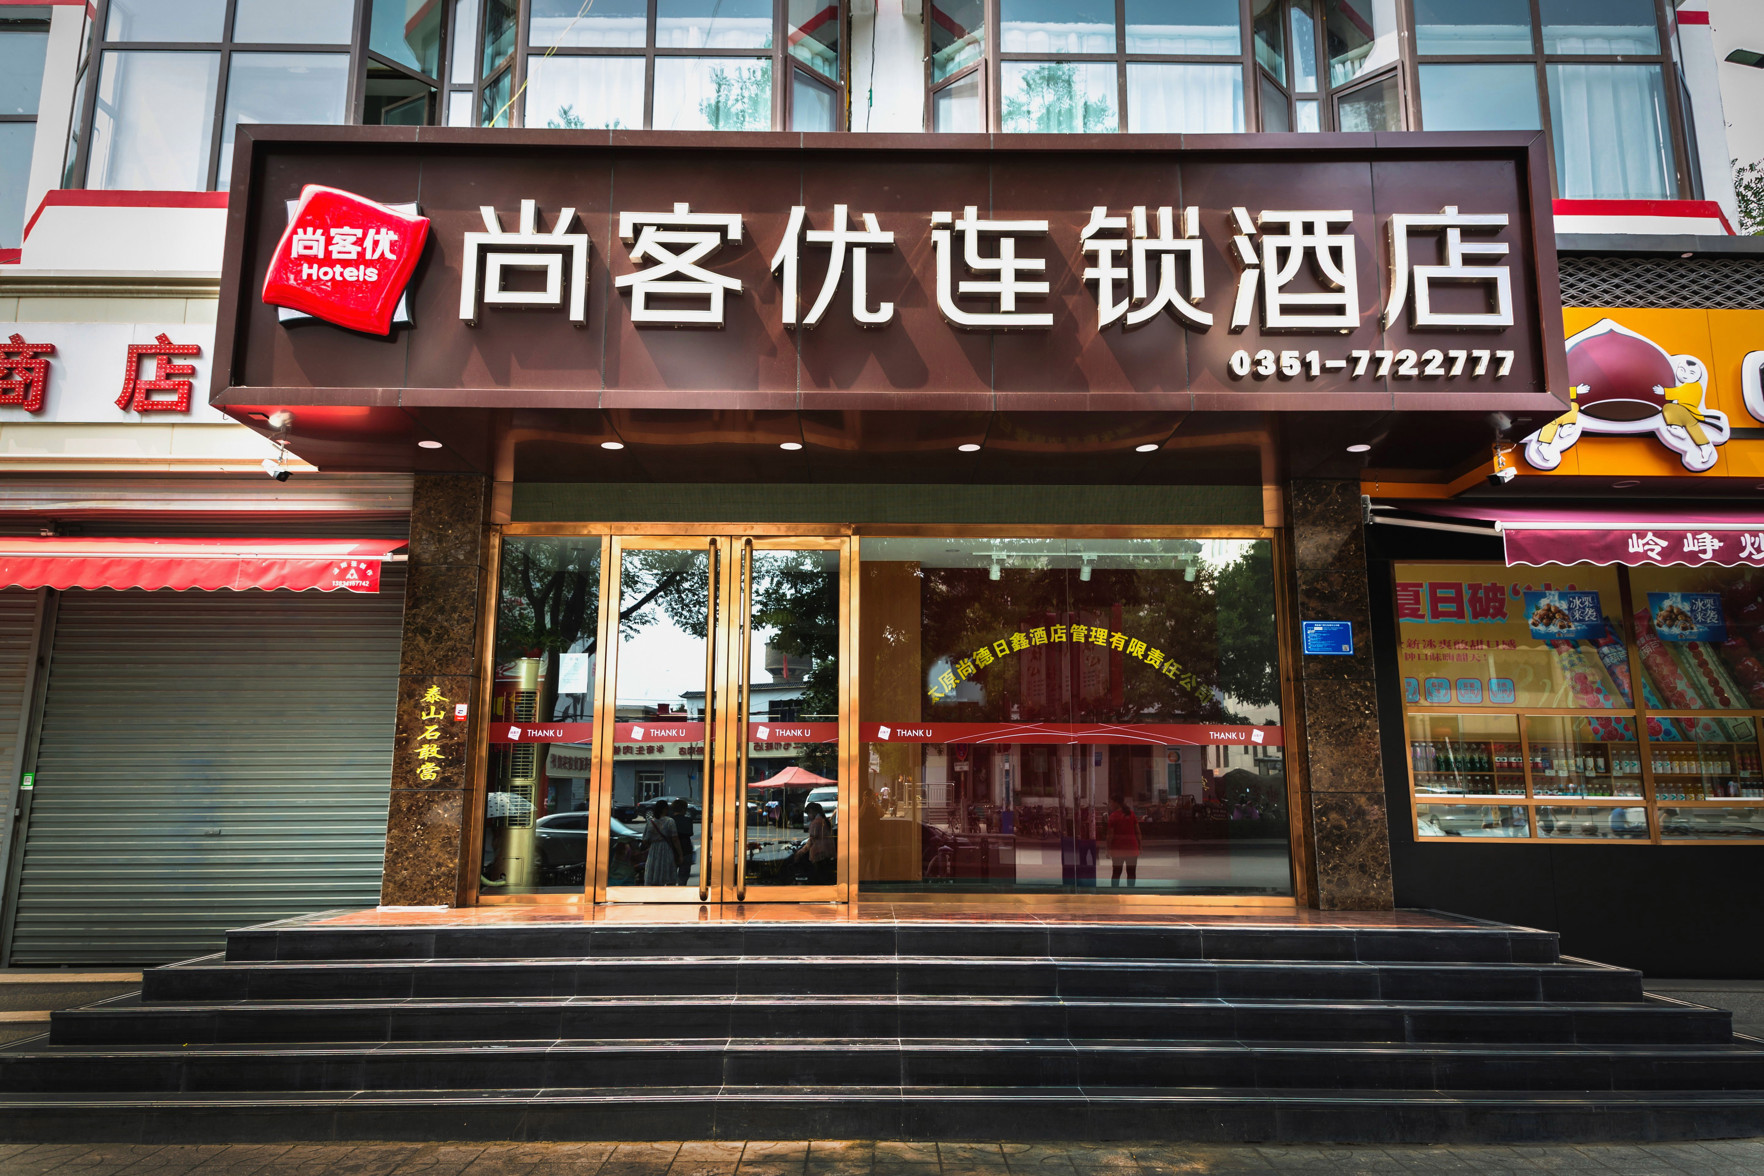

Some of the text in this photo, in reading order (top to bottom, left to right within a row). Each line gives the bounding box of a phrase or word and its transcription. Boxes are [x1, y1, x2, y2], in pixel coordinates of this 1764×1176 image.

[291, 226, 399, 261] 尚客优
[301, 263, 379, 282] Hotels
[458, 199, 1516, 331] 尚客优连锁酒店
[1229, 349, 1516, 377] 0351-7722777
[0, 333, 201, 413] 商店
[927, 624, 1216, 705] 太原尚德日鑫酒店管理有限责任公司
[527, 729, 554, 737] THANK
[556, 729, 563, 737] U
[650, 729, 686, 737] THANK U
[775, 729, 811, 737] THANK U
[896, 728, 932, 738] THANK U
[1209, 731, 1245, 740] THANK U
